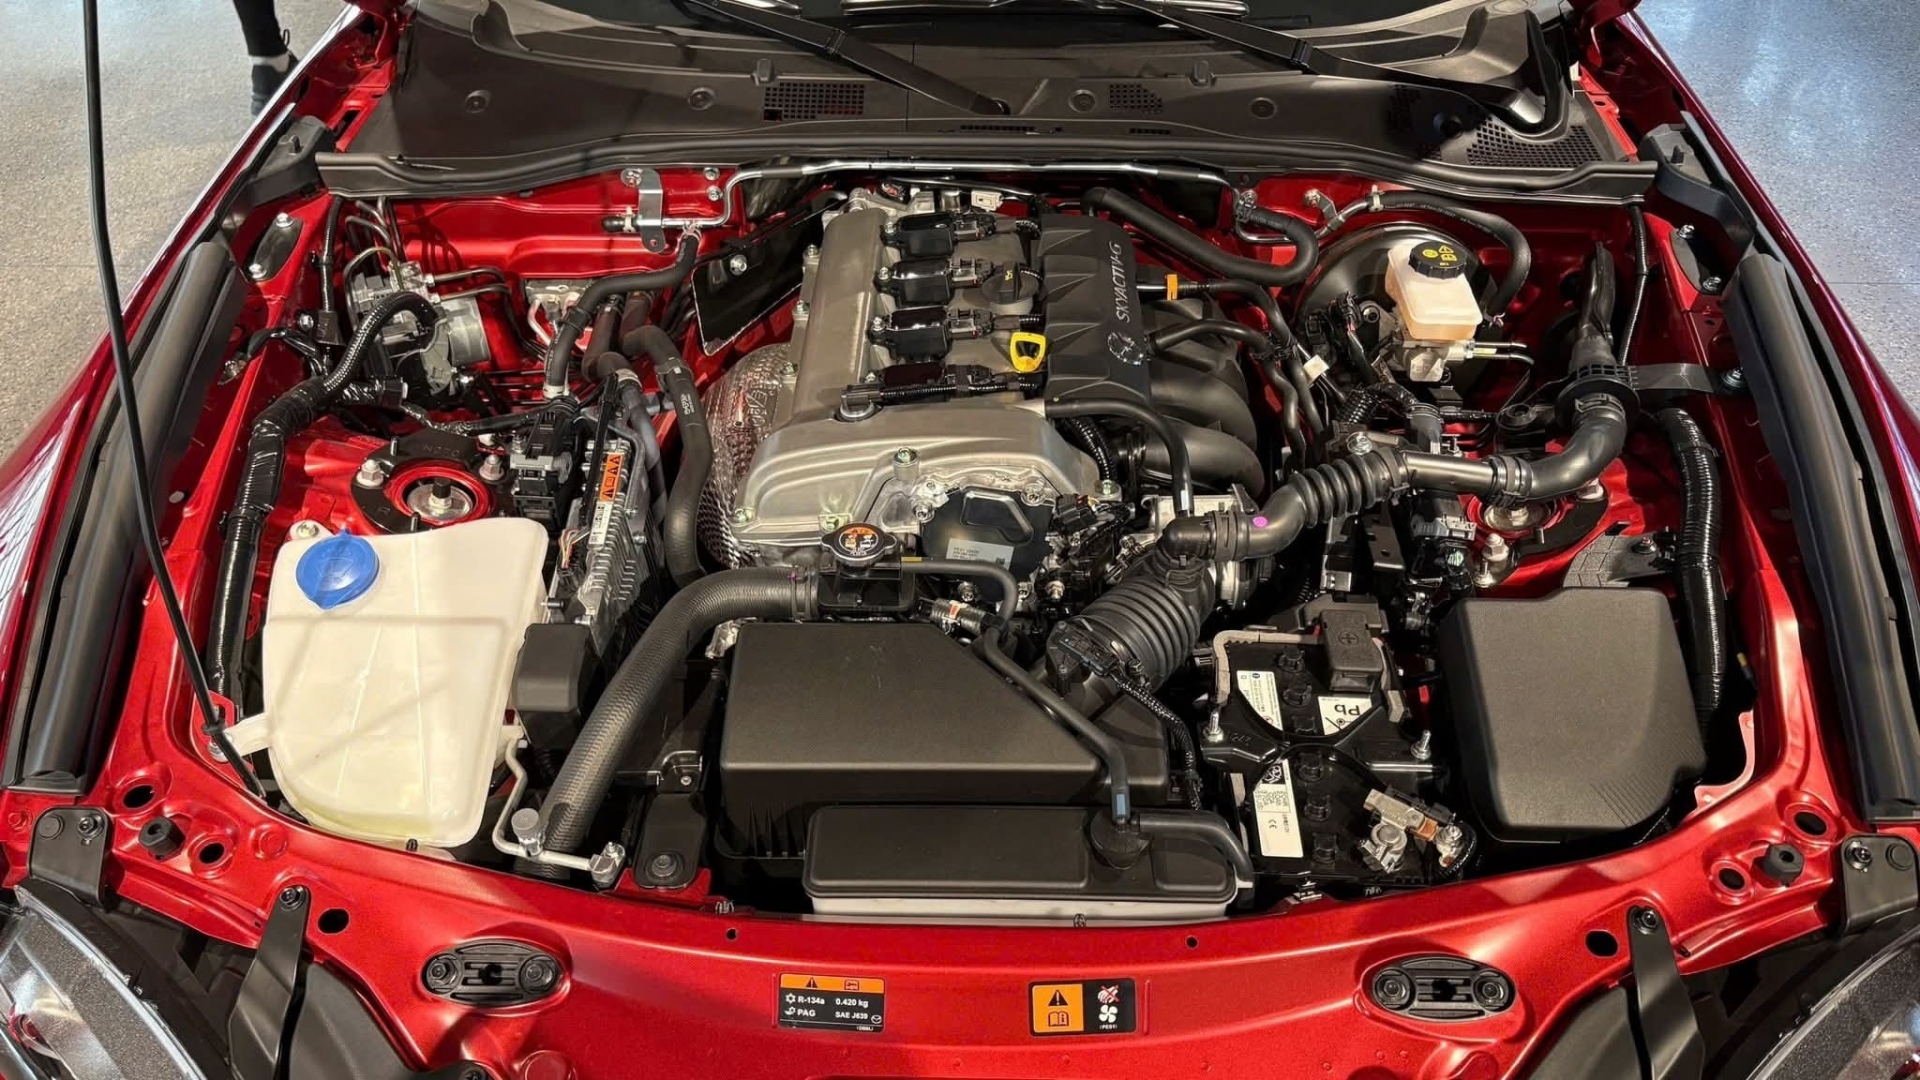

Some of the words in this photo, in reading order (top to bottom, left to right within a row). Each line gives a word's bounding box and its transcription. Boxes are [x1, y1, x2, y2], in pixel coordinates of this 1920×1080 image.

[1109, 240, 1131, 324] SKYACTIV-G
[1334, 704, 1360, 716] Pb
[797, 996, 825, 1005] R-134a
[835, 998, 857, 1006] 0.420
[858, 998, 869, 1008] kg
[797, 1009, 816, 1017] PAG
[851, 1012, 868, 1020] J639
